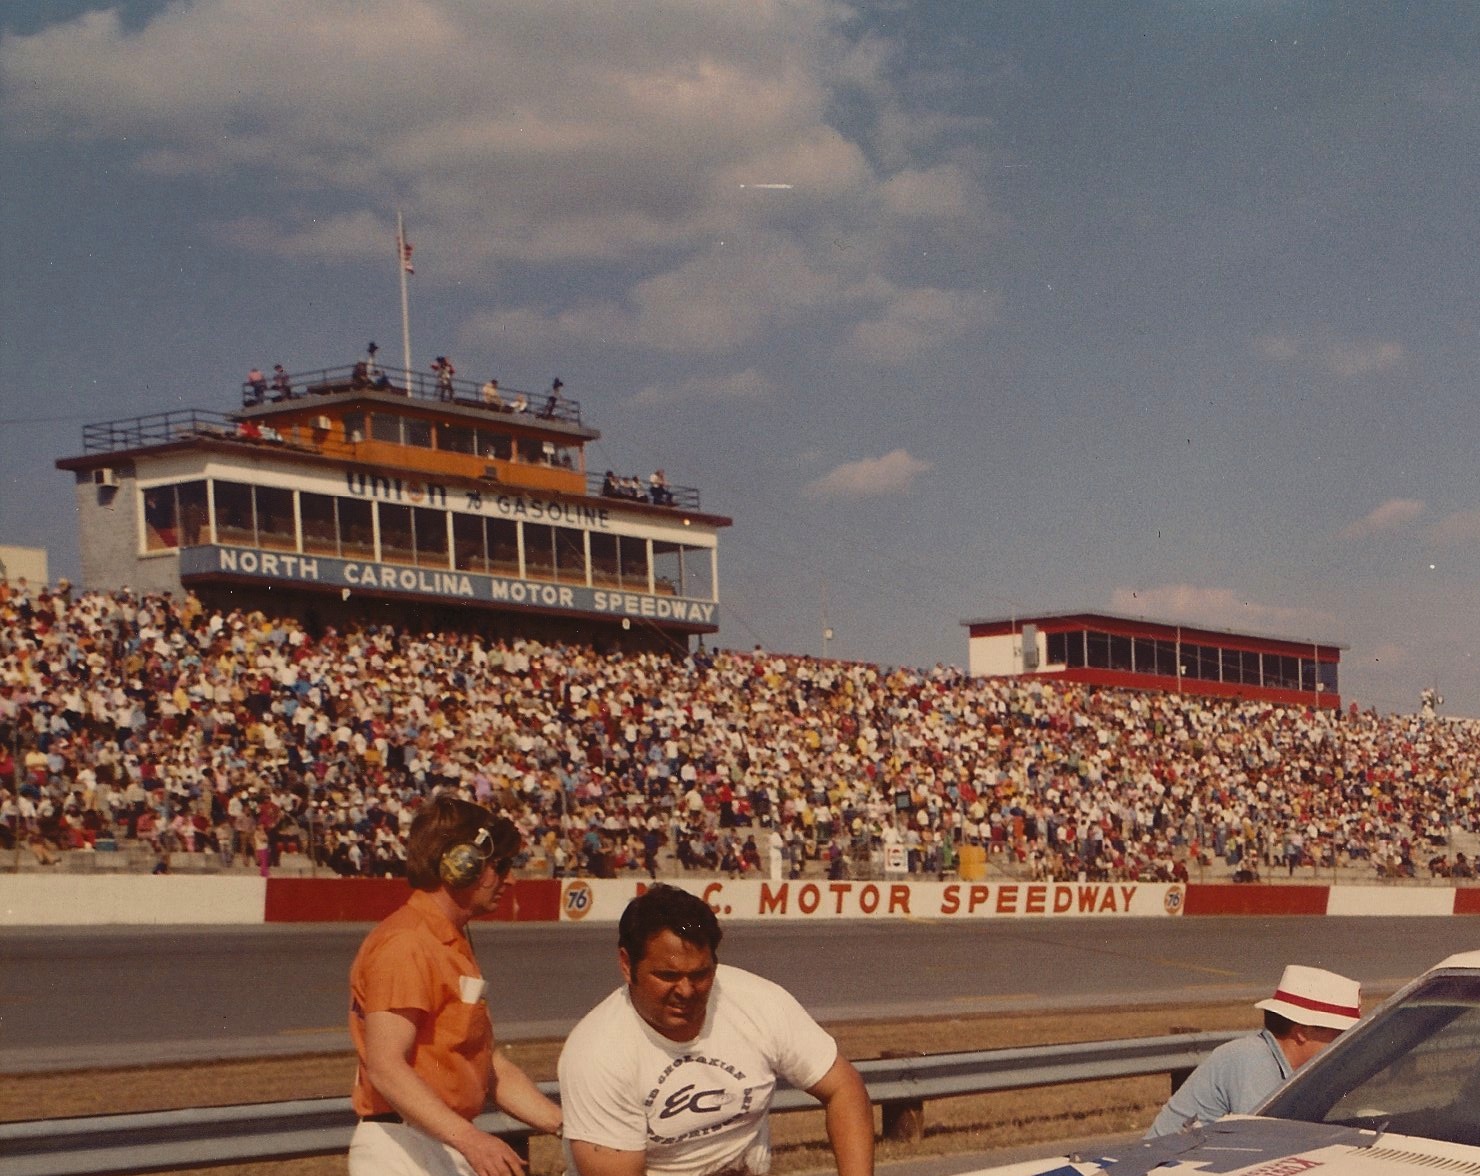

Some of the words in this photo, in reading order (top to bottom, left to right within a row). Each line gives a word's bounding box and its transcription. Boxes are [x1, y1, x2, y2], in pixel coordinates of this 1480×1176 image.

[497, 494, 610, 529] GASOLINE
[219, 548, 319, 580] NORTH
[343, 563, 475, 596] CAROLINA
[491, 579, 574, 607] MOTOR
[593, 592, 715, 623] SPEEDWAY
[568, 889, 588, 909] 76
[758, 883, 912, 915] MOTOR
[940, 884, 1138, 915] SPEEDWAY
[1167, 892, 1181, 907] 76
[659, 1084, 726, 1119] EC
